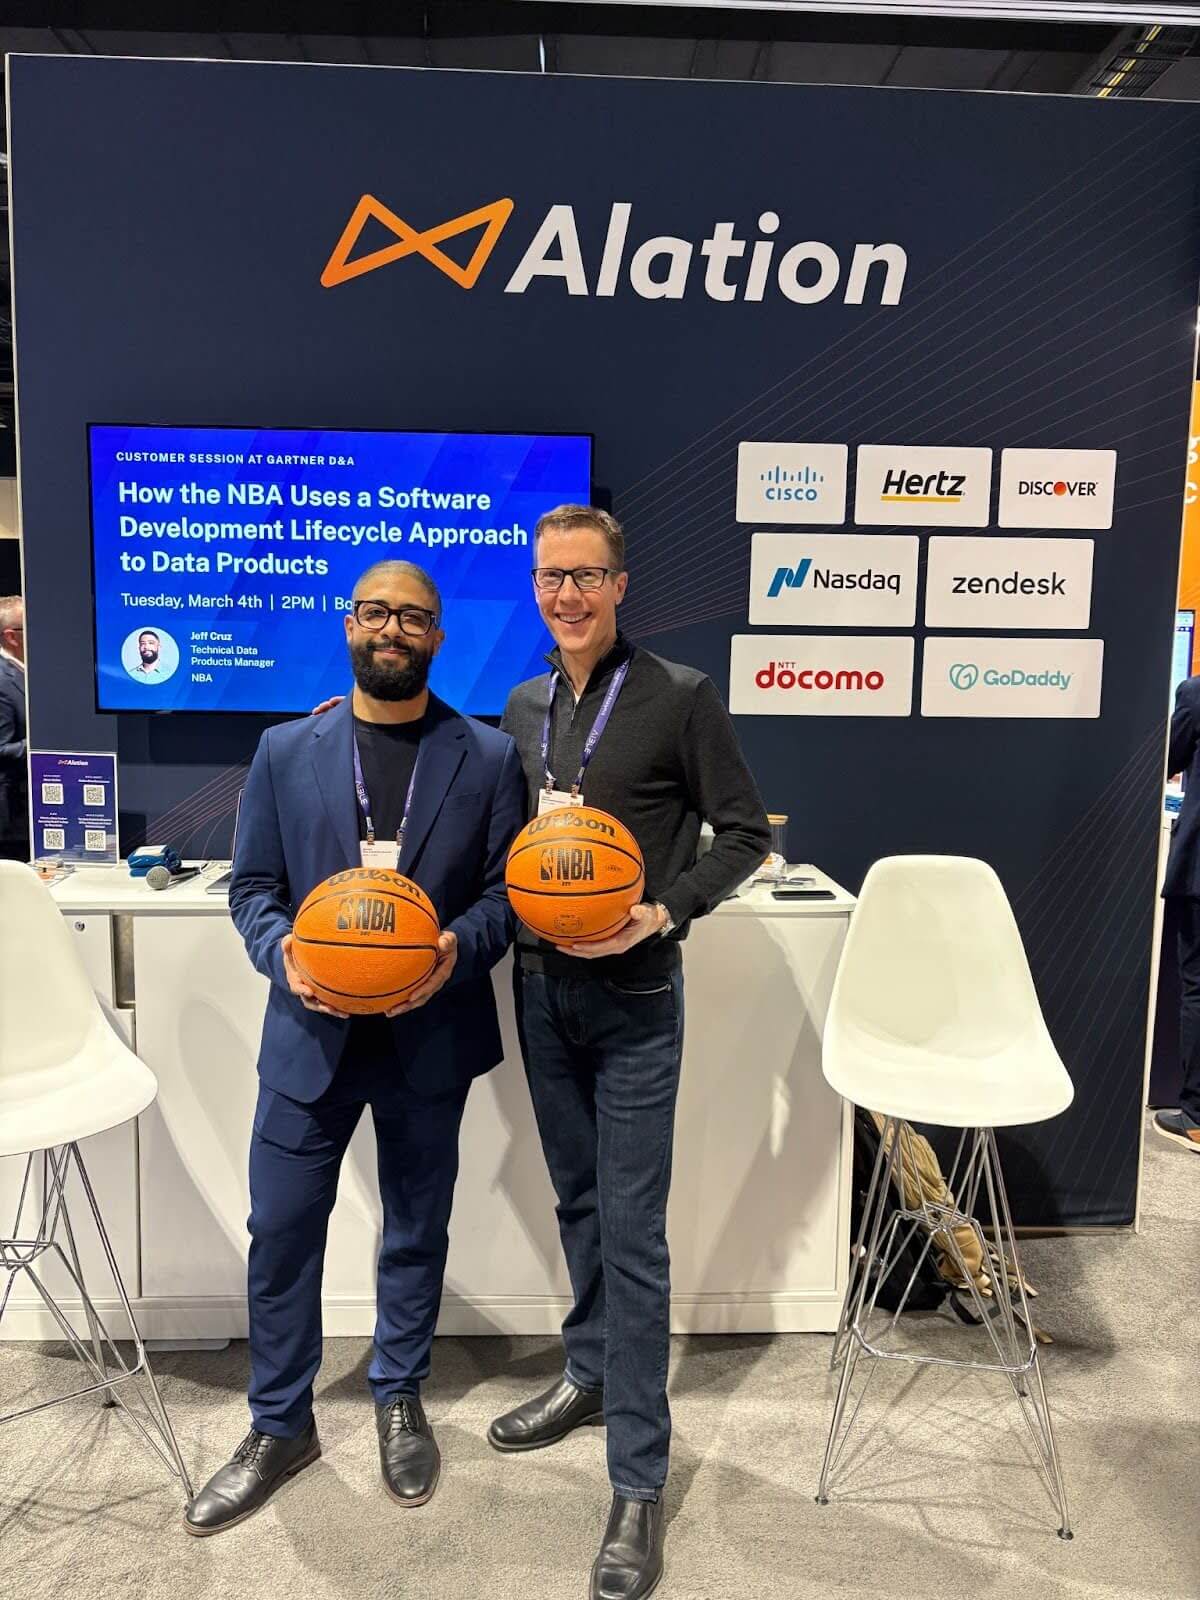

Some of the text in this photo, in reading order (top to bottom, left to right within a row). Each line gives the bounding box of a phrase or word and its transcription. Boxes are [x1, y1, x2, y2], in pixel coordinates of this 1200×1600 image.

[503, 202, 907, 305] Alation
[116, 451, 355, 466] CUSTOMER SESSION AT GARTNER D&A
[765, 487, 818, 501] CISCO
[881, 469, 967, 497] Hertz
[1018, 480, 1097, 497] DISCOVER
[118, 481, 491, 511] How the NBA Uses a Software
[119, 516, 528, 548] Development Lifecycle Approach
[119, 551, 329, 576] to Data Products
[813, 568, 901, 596] Nasdaq
[951, 571, 1067, 596] zendesk
[120, 592, 185, 610] Tuesday,
[188, 594, 234, 608] March
[237, 594, 263, 609] 4th
[281, 595, 315, 610] 2PM
[190, 631, 233, 641] Jeff Cruz
[190, 644, 258, 655] Technical Data
[190, 656, 276, 669] Products Manager
[777, 661, 797, 669] NTT
[191, 672, 213, 683] NBA
[754, 661, 885, 691] docomo
[983, 669, 1072, 691] GoDaddy
[528, 811, 616, 838] Wilson
[556, 848, 594, 881] NBA
[328, 869, 422, 900] Wilson
[355, 896, 395, 933] NBA
